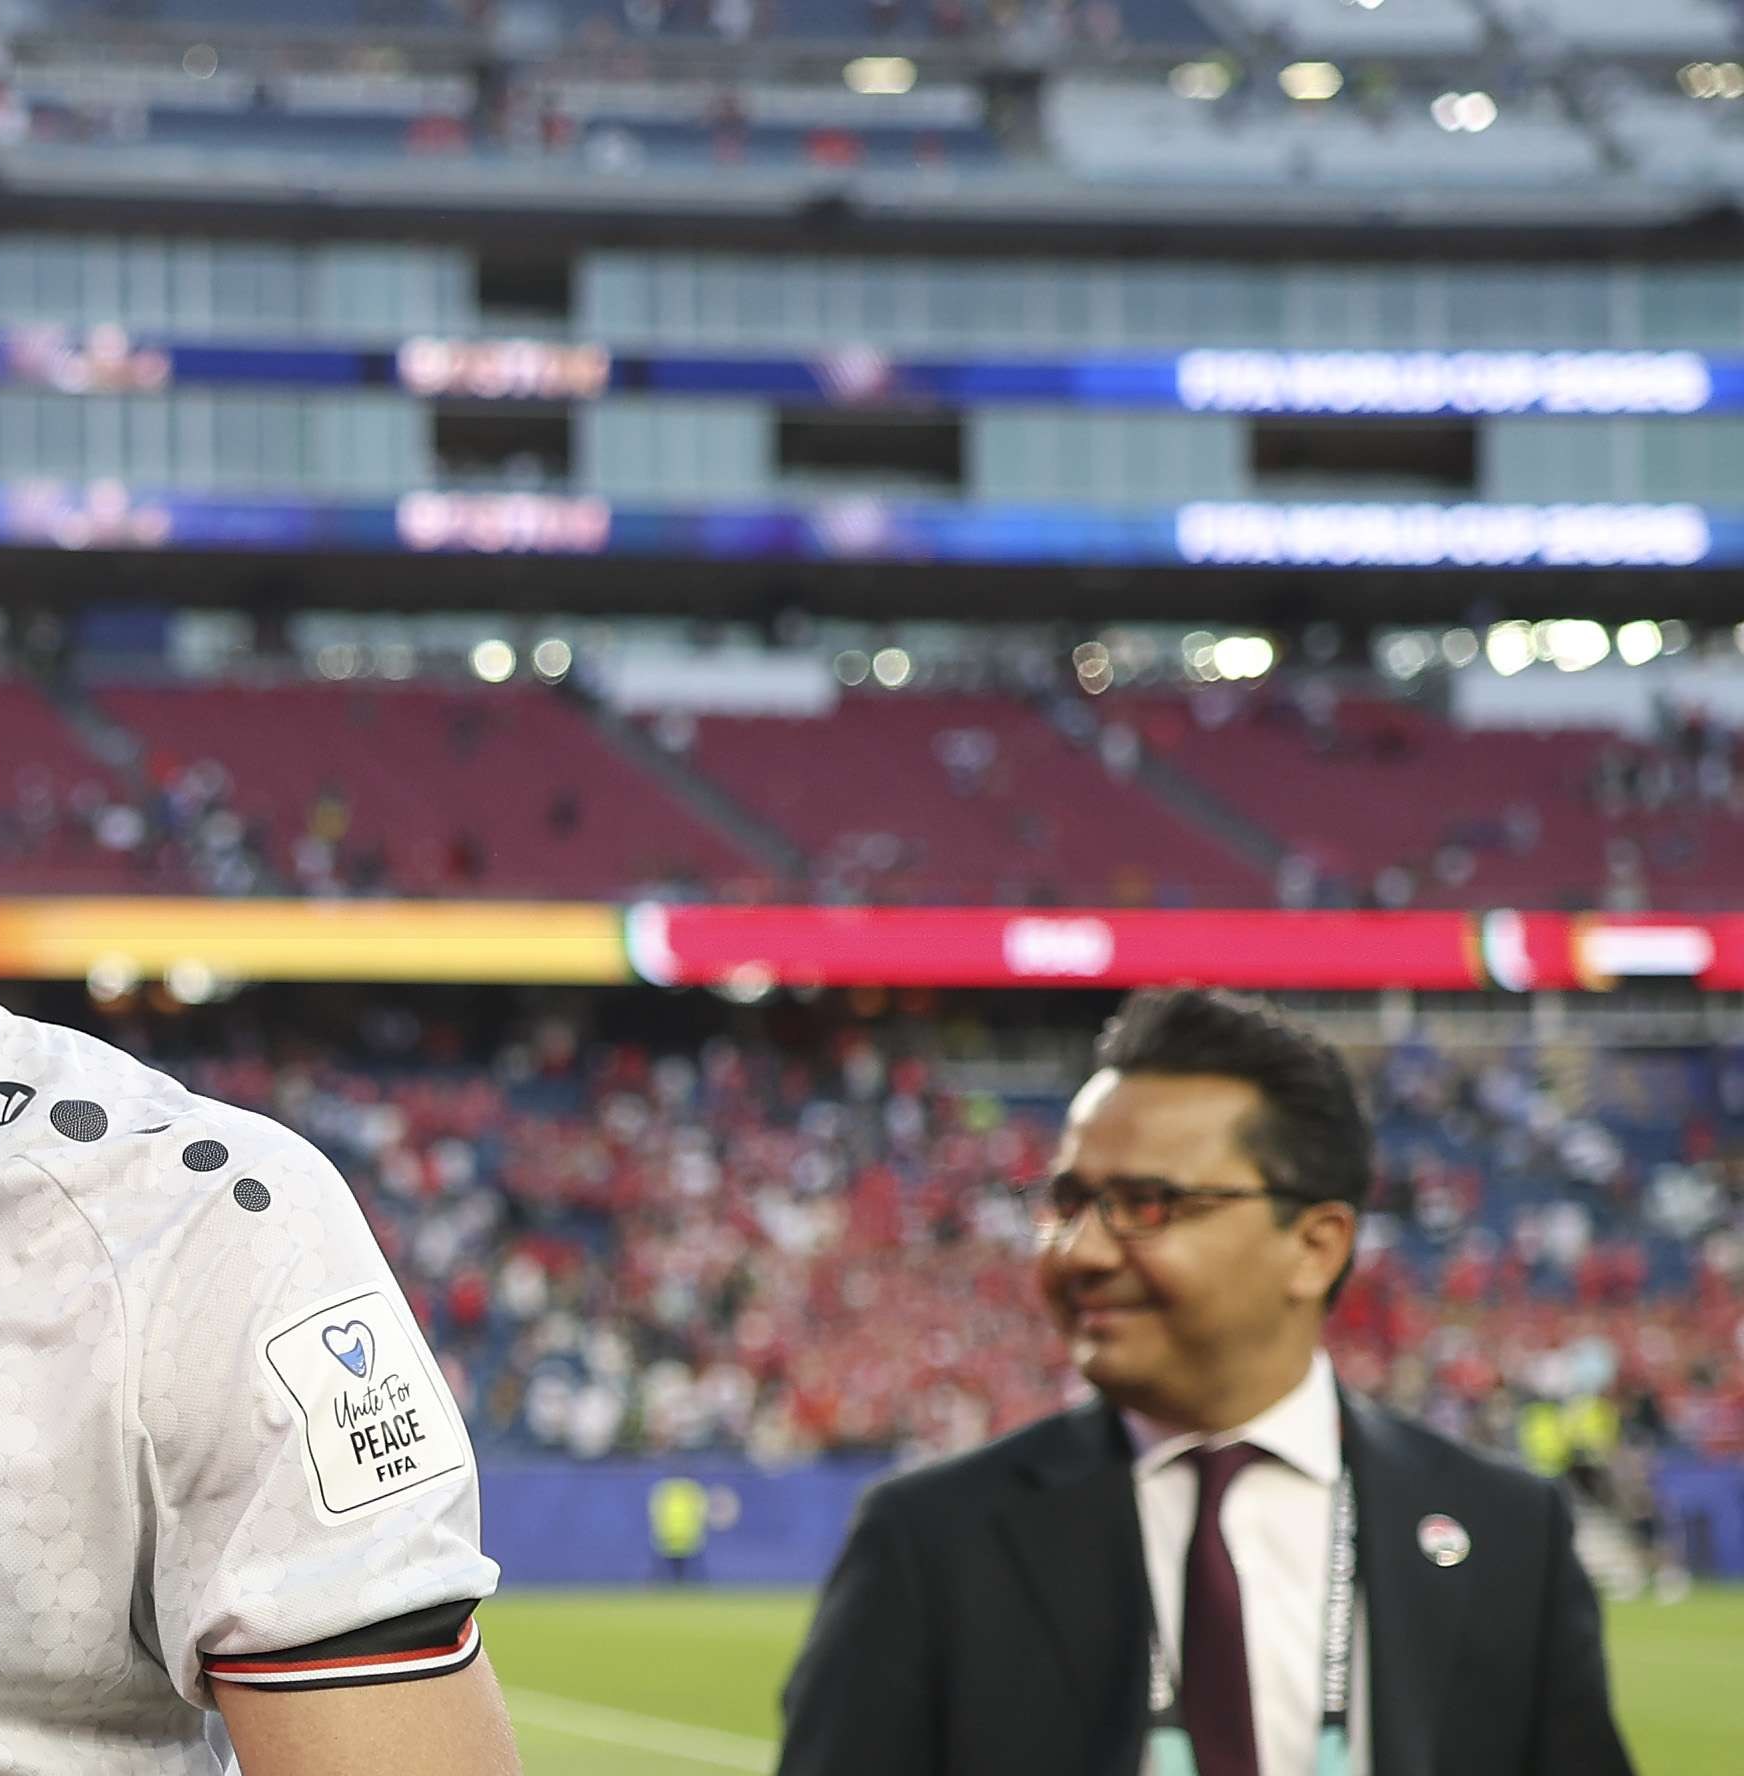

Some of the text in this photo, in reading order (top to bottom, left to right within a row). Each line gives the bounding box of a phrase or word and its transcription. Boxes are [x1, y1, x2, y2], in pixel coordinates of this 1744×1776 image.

[334, 1374, 411, 1429] Unite For
[350, 1408, 426, 1465] PEACE
[376, 1456, 417, 1482] FIFA
